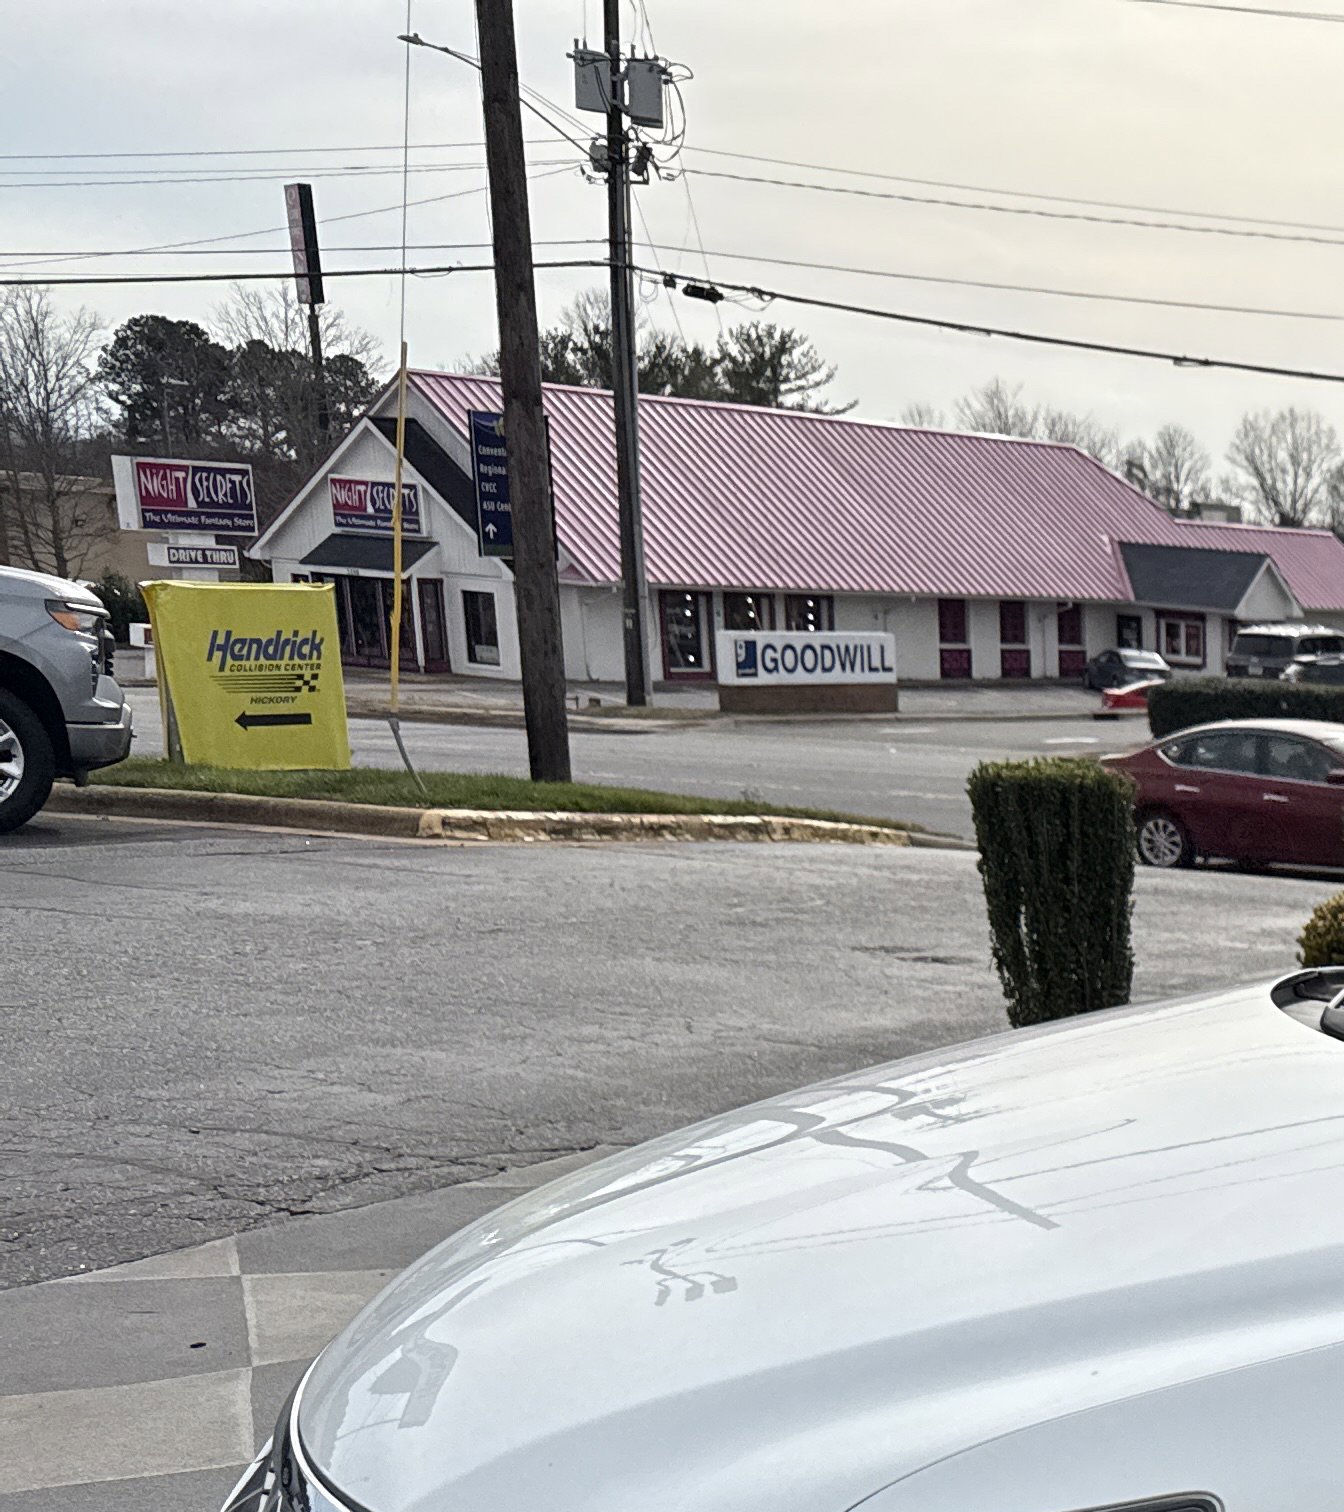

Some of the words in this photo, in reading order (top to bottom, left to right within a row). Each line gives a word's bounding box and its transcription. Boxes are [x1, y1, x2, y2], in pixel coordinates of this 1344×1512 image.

[479, 463, 506, 476] Regiona
[194, 471, 251, 505] SECRETS
[481, 481, 497, 493] CVCC
[482, 501, 494, 512] ASU
[497, 501, 512, 512] Cent
[144, 512, 160, 523] The
[161, 512, 199, 525] Ultimate
[200, 514, 233, 528] Fantasy
[233, 516, 254, 528] Store
[169, 548, 203, 563] DRIVE
[205, 550, 234, 564] THRU
[206, 629, 325, 673] Hendrick
[761, 643, 894, 674] GOODWILL
[229, 663, 282, 673] COLLISION
[283, 662, 322, 672] CENTER
[249, 695, 298, 705] HICKORY
